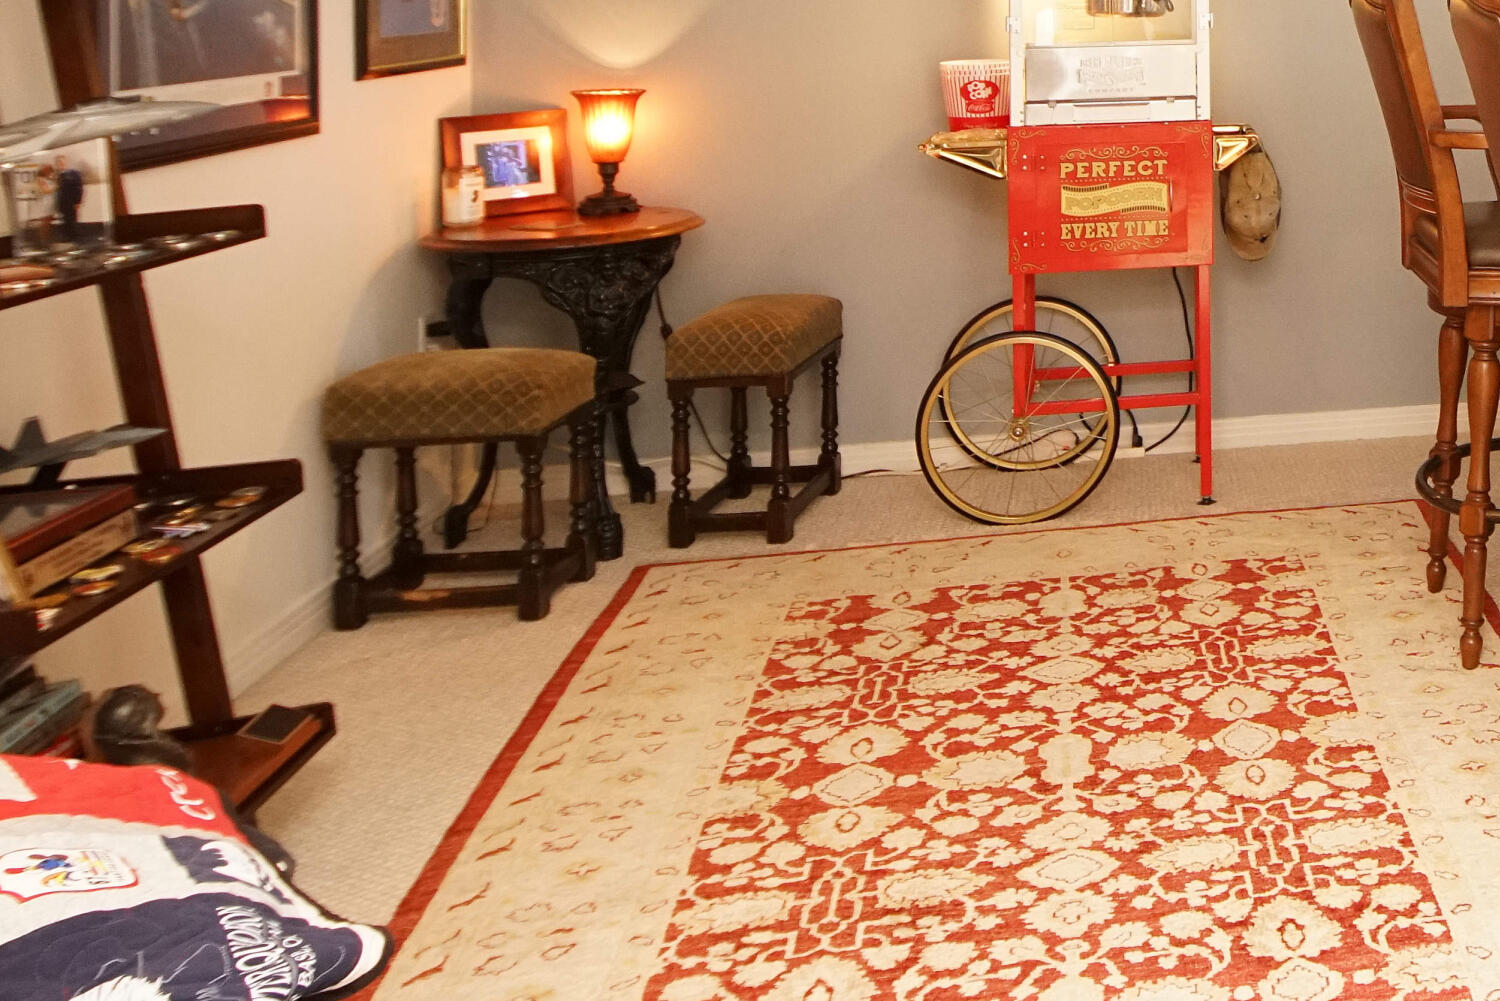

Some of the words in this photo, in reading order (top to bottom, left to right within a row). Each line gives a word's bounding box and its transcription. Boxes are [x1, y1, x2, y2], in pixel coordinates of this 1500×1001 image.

[1060, 160, 1168, 178] PERFECT
[1064, 187, 1163, 211] POPCORN
[1061, 221, 1120, 240] EVERY
[1124, 219, 1169, 237] TIME
